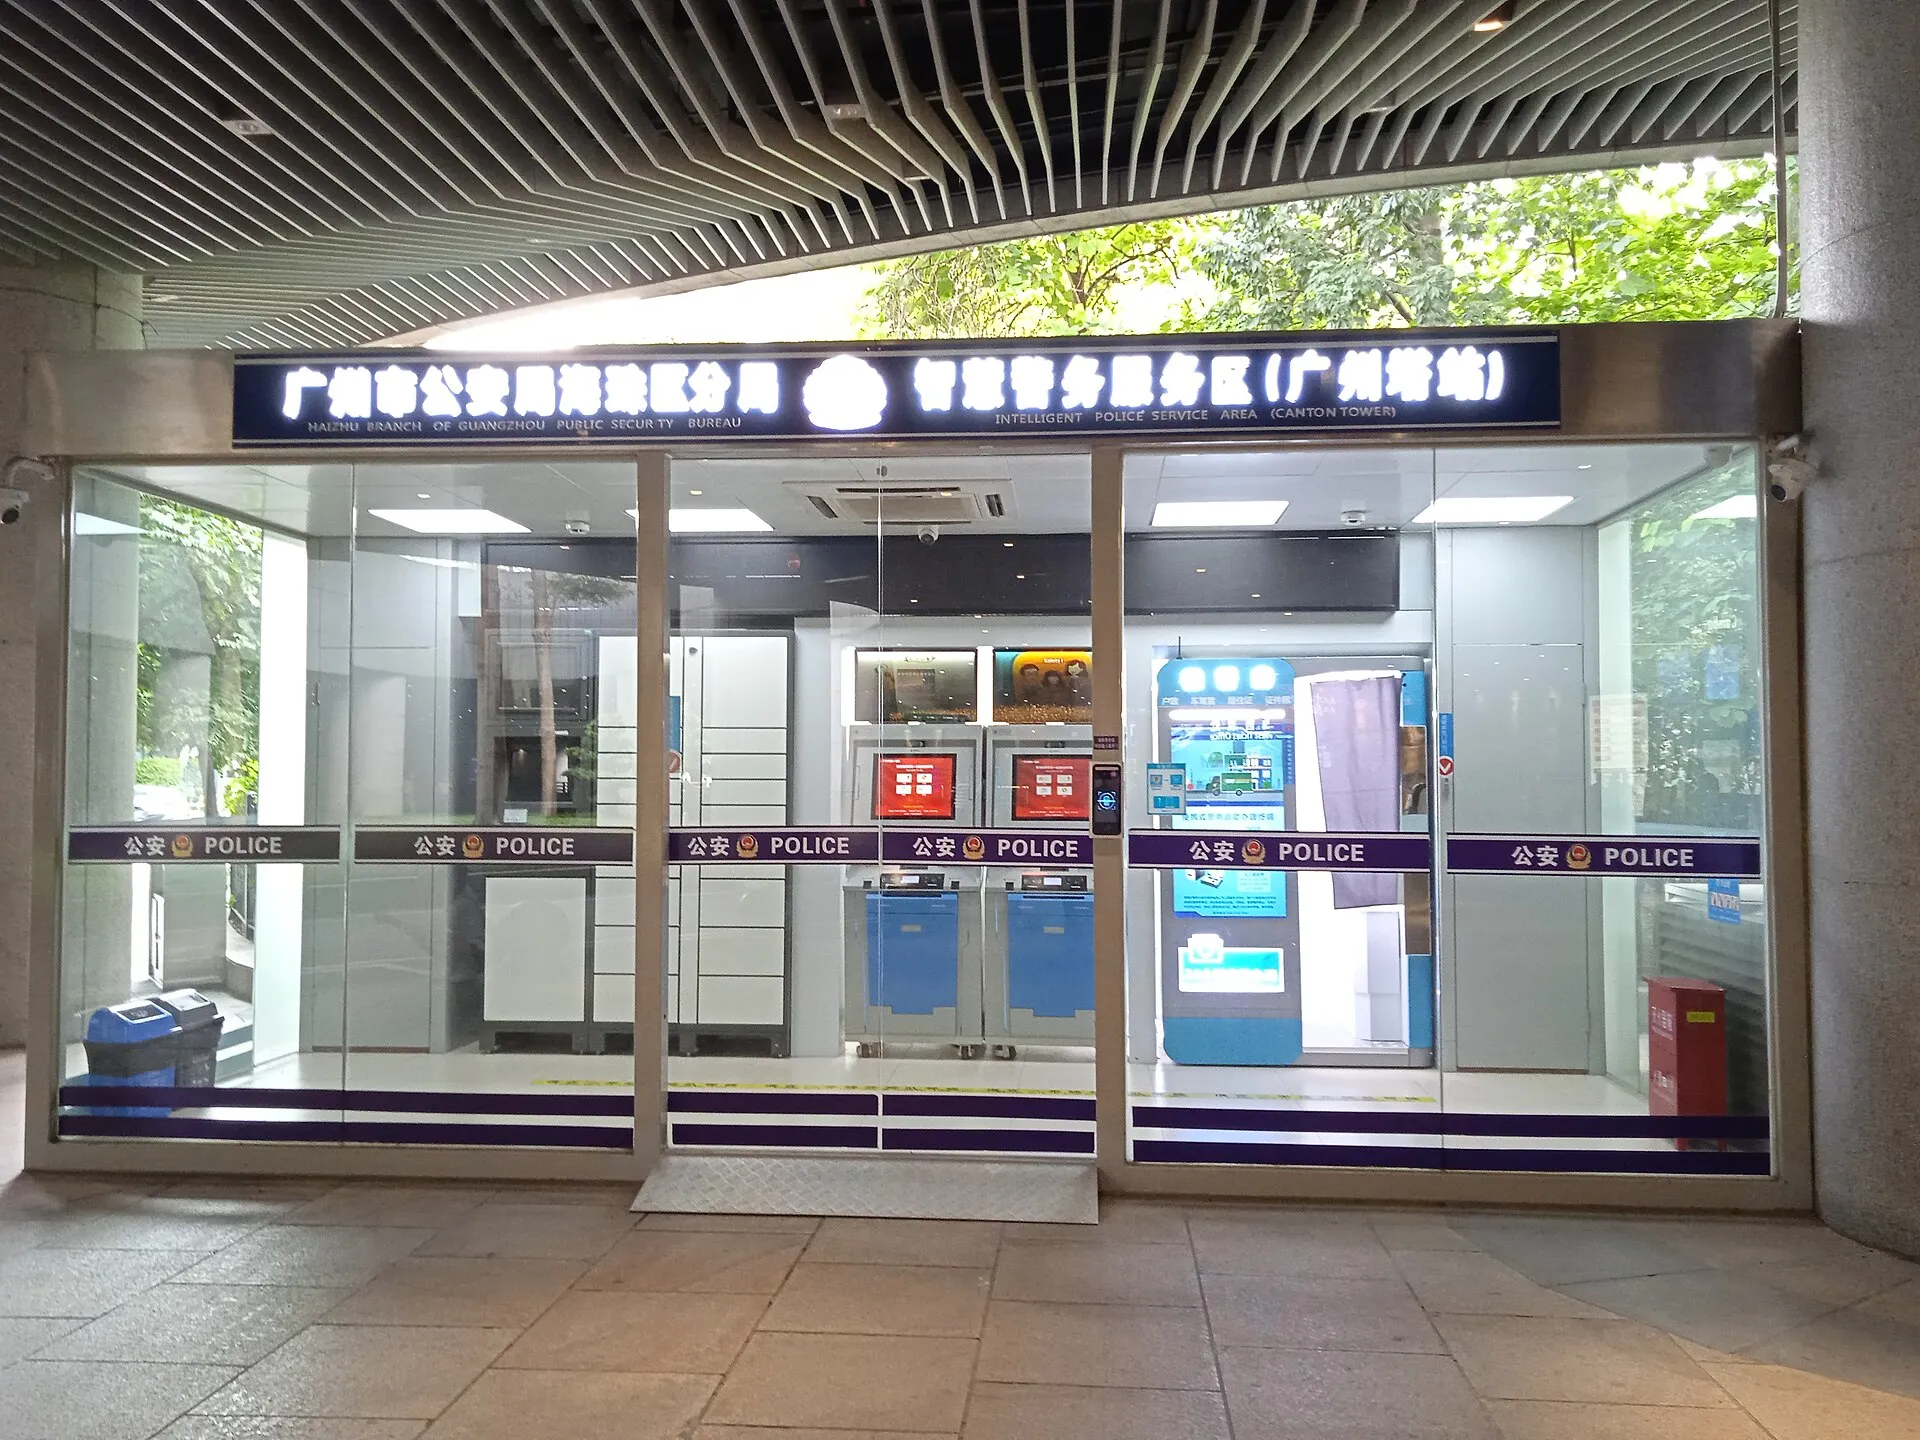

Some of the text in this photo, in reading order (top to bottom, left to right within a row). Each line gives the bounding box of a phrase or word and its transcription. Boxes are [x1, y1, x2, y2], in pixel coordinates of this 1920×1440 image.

[307, 421, 359, 432] HAIZHU
[367, 421, 422, 432] BRANCH
[433, 421, 451, 432] OF
[458, 420, 546, 432] GUANGZHOU
[556, 418, 604, 430] PUBLIC
[688, 417, 742, 428] BUREAU
[995, 406, 1396, 424] INTELLIGENT POLICE SERVICE AREA (CANTON TOWER)
[125, 835, 282, 857] 公安 POLICE
[414, 835, 574, 857] 公安 POLICE
[687, 836, 850, 857] 公安 POLICE
[912, 836, 1079, 858] 公安 POLICE
[1189, 840, 1365, 862] 公安 POLICE
[1511, 845, 1694, 867] 公安 POLICE
